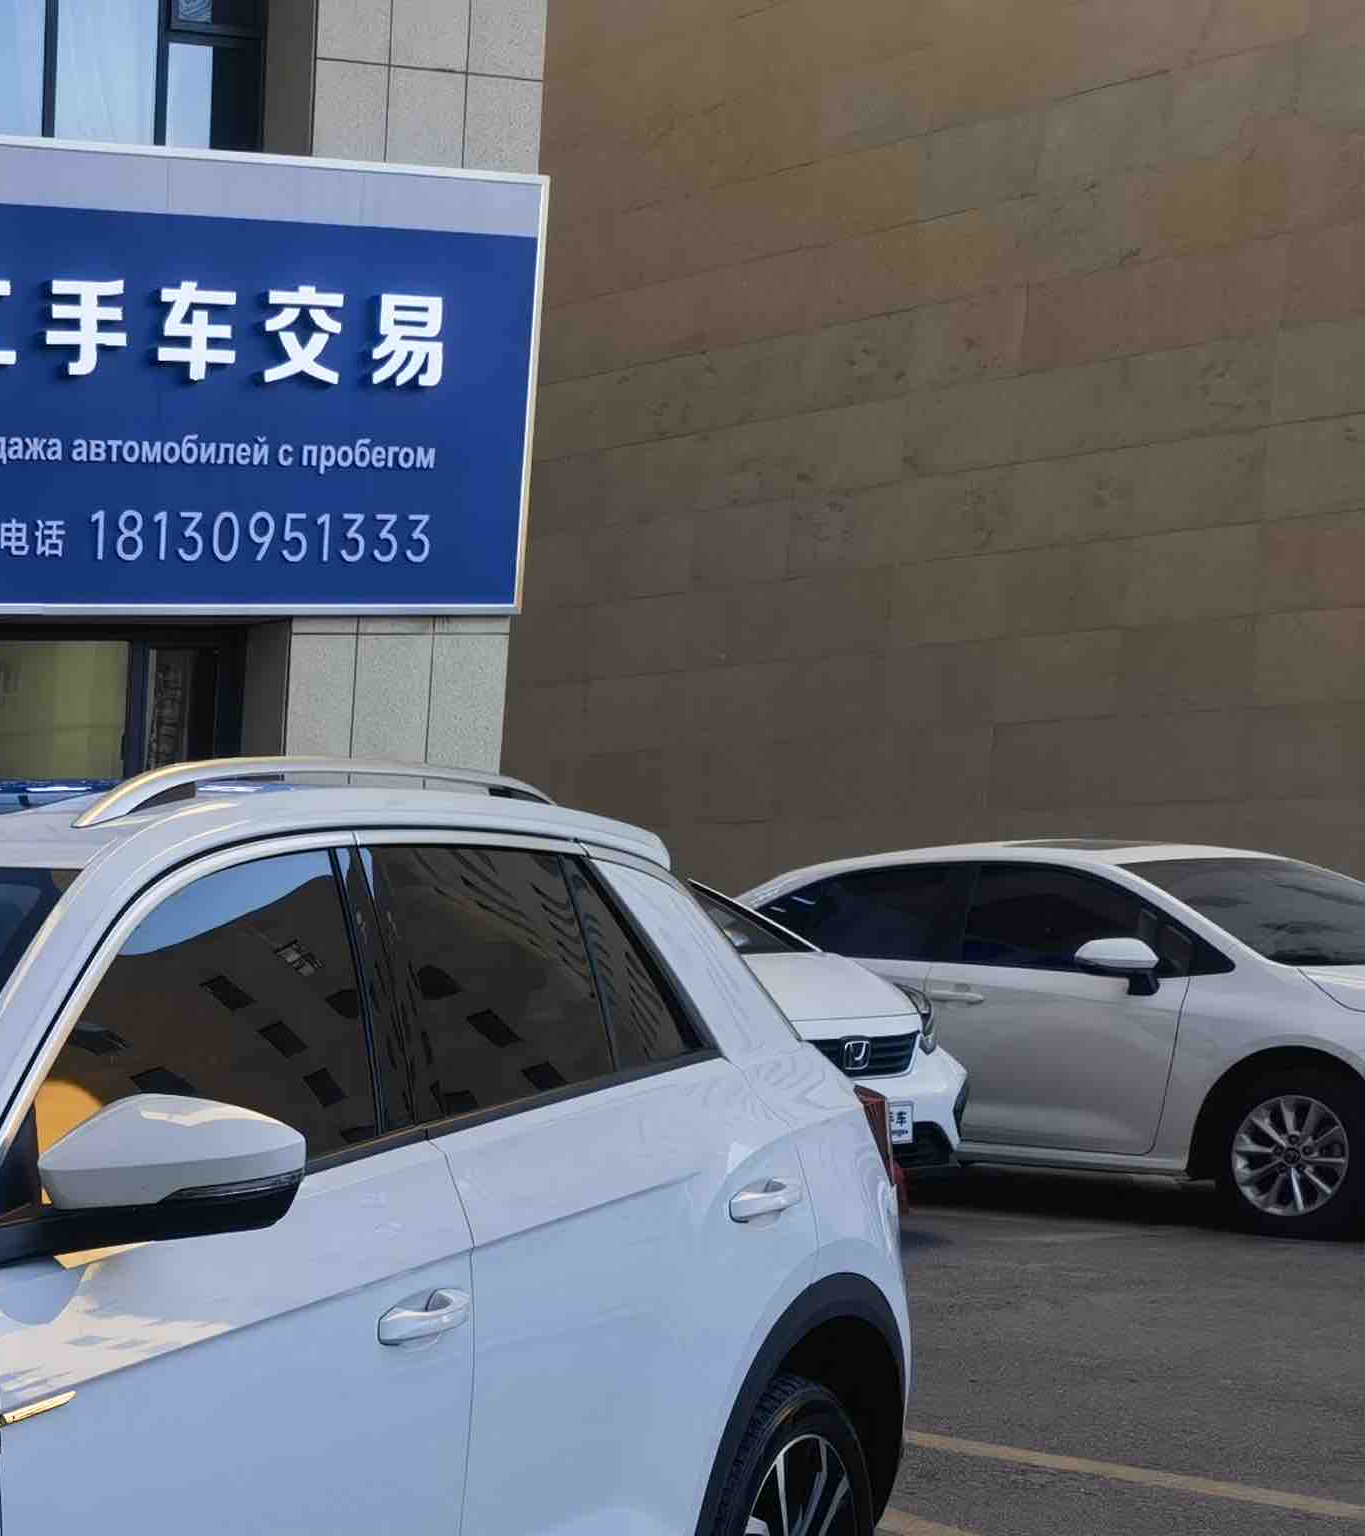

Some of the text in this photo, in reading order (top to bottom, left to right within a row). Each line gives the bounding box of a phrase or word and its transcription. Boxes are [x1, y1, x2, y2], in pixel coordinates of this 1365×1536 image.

[71, 433, 269, 467] автомобилей
[278, 444, 293, 466] с
[301, 440, 436, 474] пробегом
[89, 509, 432, 564] 18130951333
